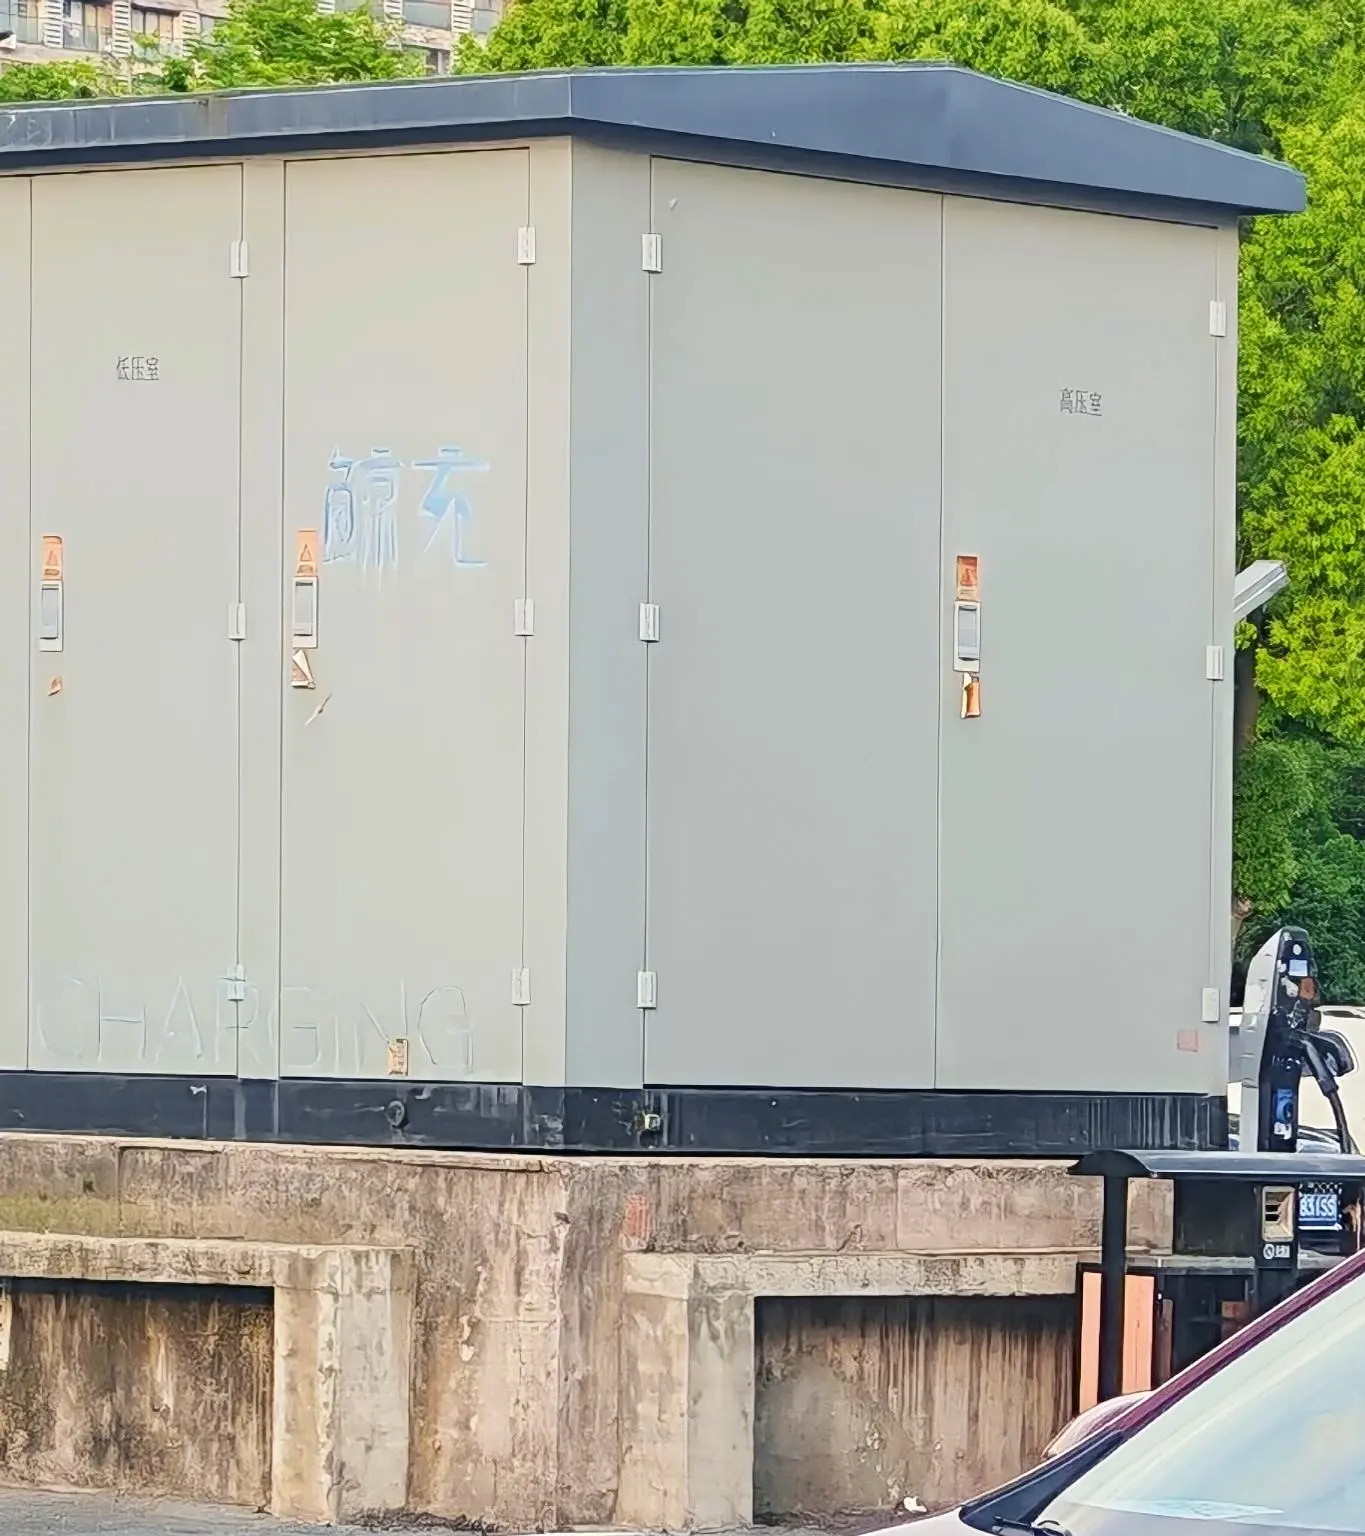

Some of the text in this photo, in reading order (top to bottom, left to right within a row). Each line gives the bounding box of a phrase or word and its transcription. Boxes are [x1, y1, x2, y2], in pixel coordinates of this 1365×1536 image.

[116, 354, 160, 381] 低压室
[1060, 387, 1103, 417] 高压室
